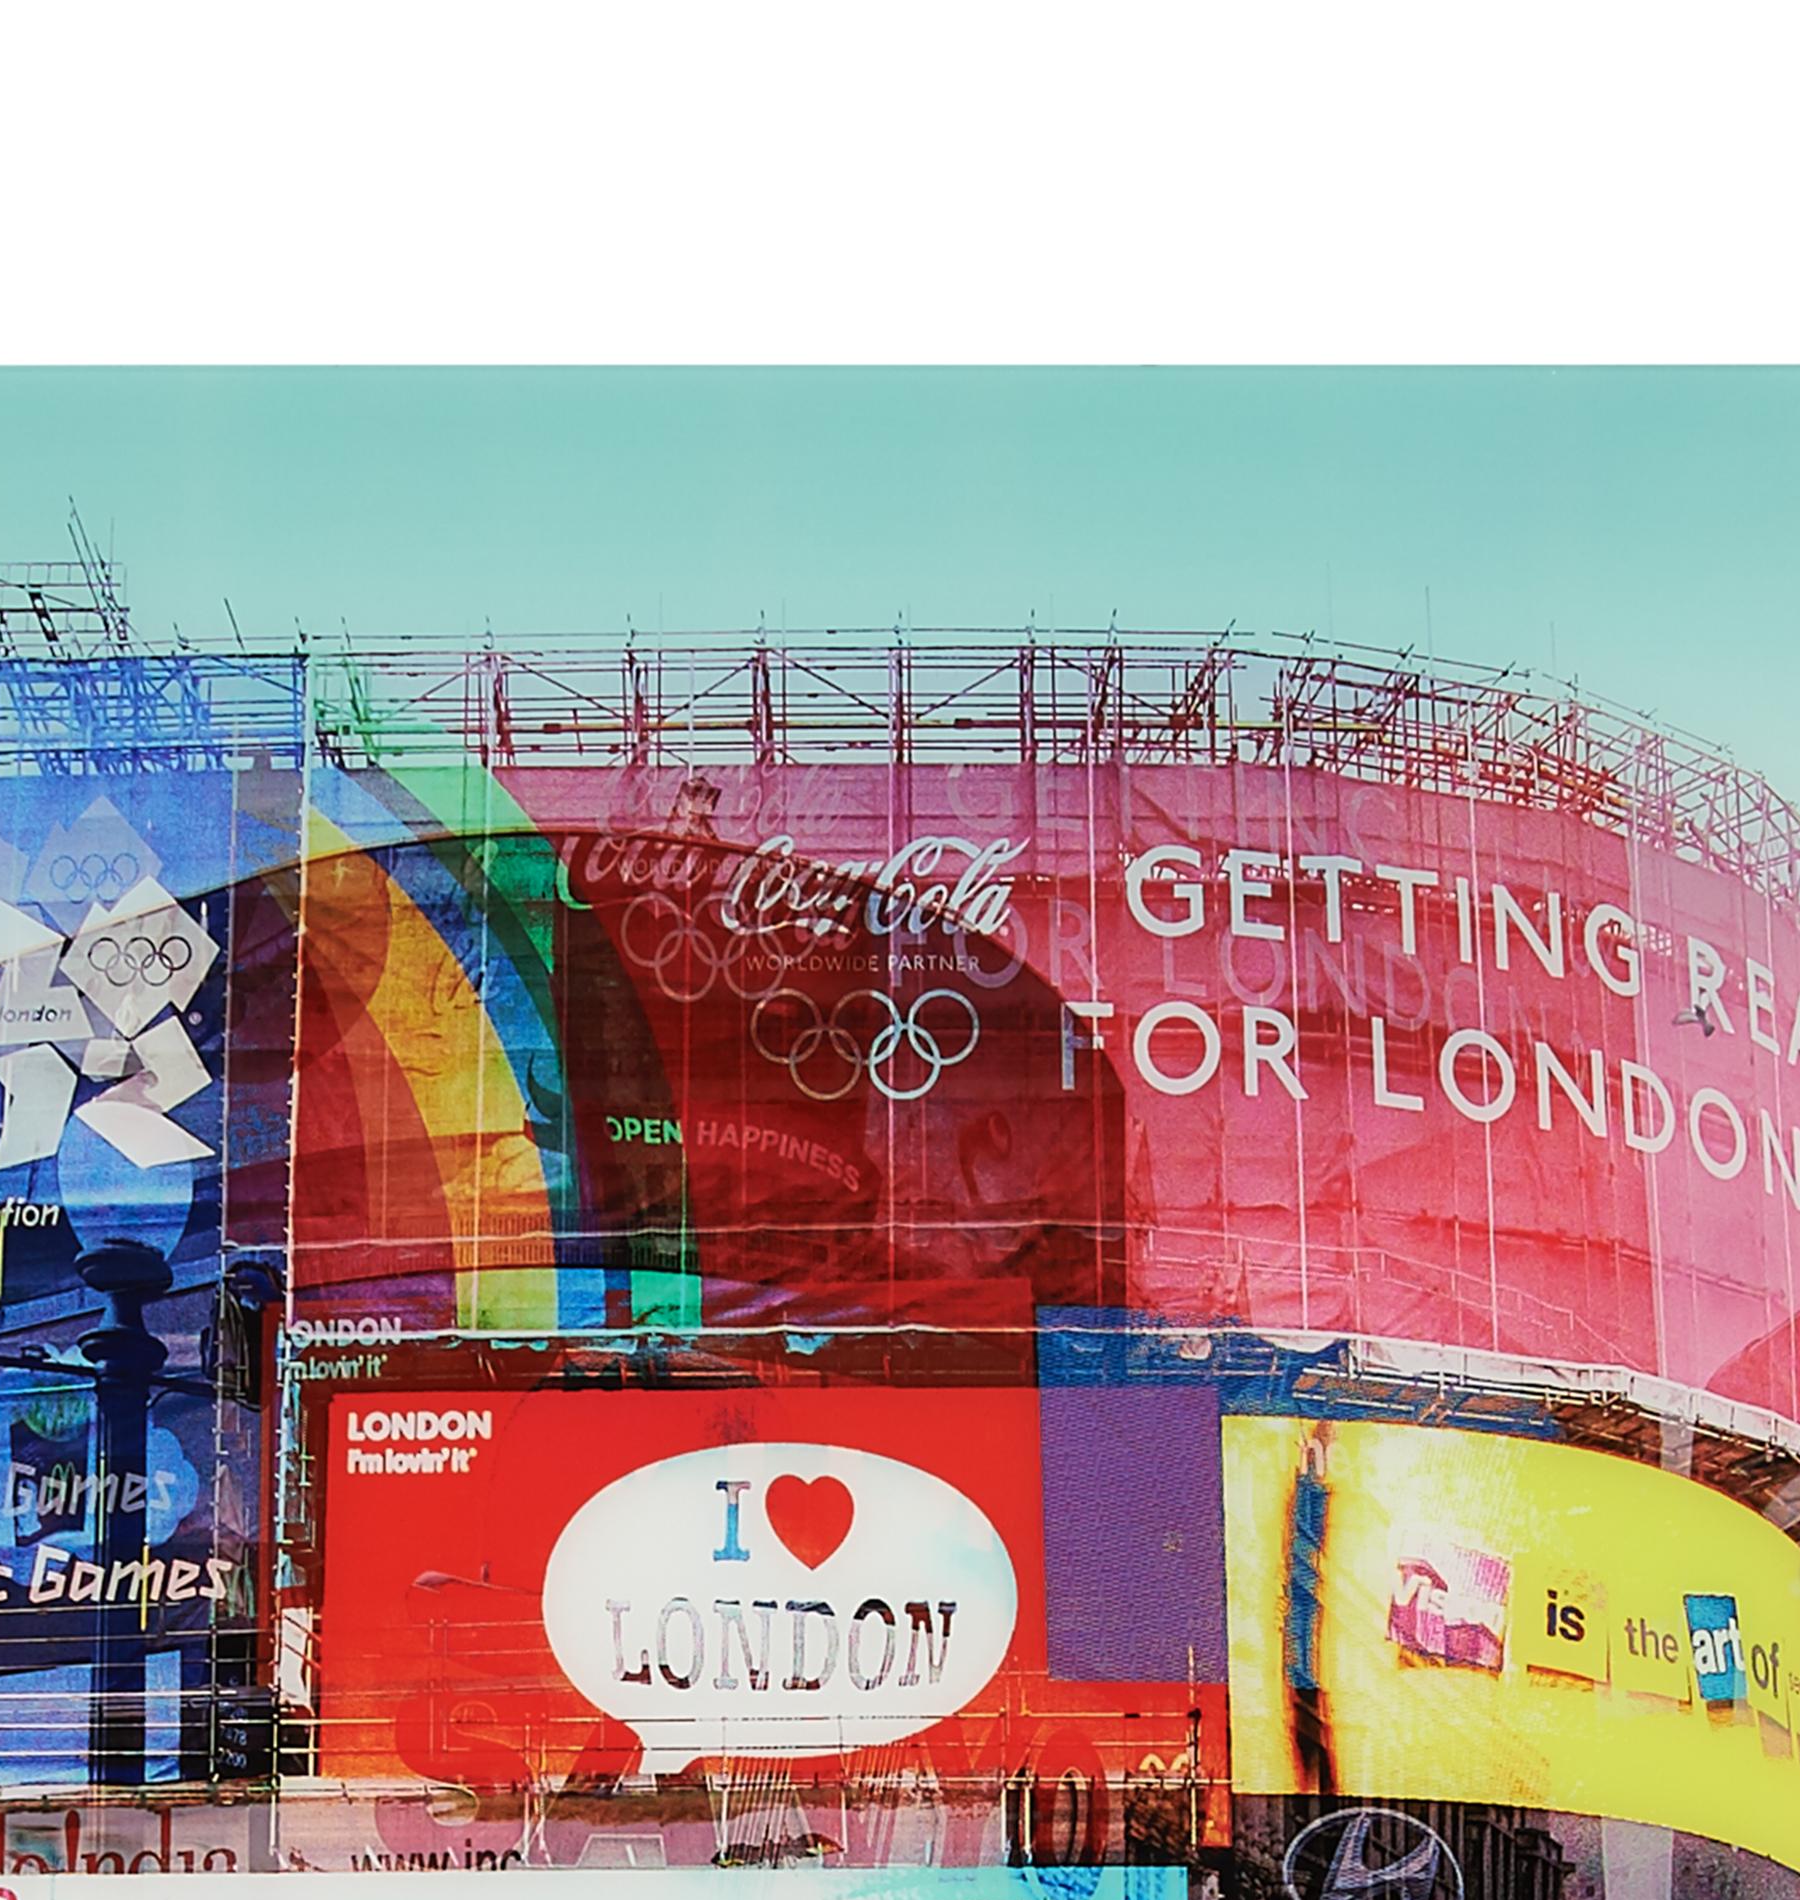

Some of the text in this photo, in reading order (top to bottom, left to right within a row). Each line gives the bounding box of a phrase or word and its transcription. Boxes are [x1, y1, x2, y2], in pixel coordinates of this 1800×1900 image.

[719, 833, 1032, 938] Coca-Cola
[1125, 843, 1641, 998] GETTING
[745, 954, 981, 973] WORLDWIDE PARTNER
[1062, 1000, 1309, 1101] FOR
[605, 1115, 862, 1193] OPEN HAPPINESS
[277, 1316, 402, 1351] ONDON
[346, 1410, 493, 1442] LONDON
[3, 1459, 178, 1520] Games
[712, 1479, 751, 1563] I
[28, 1543, 233, 1604] Games
[604, 1597, 959, 1693] LONDON
[1545, 1589, 1782, 1699] is the art of
